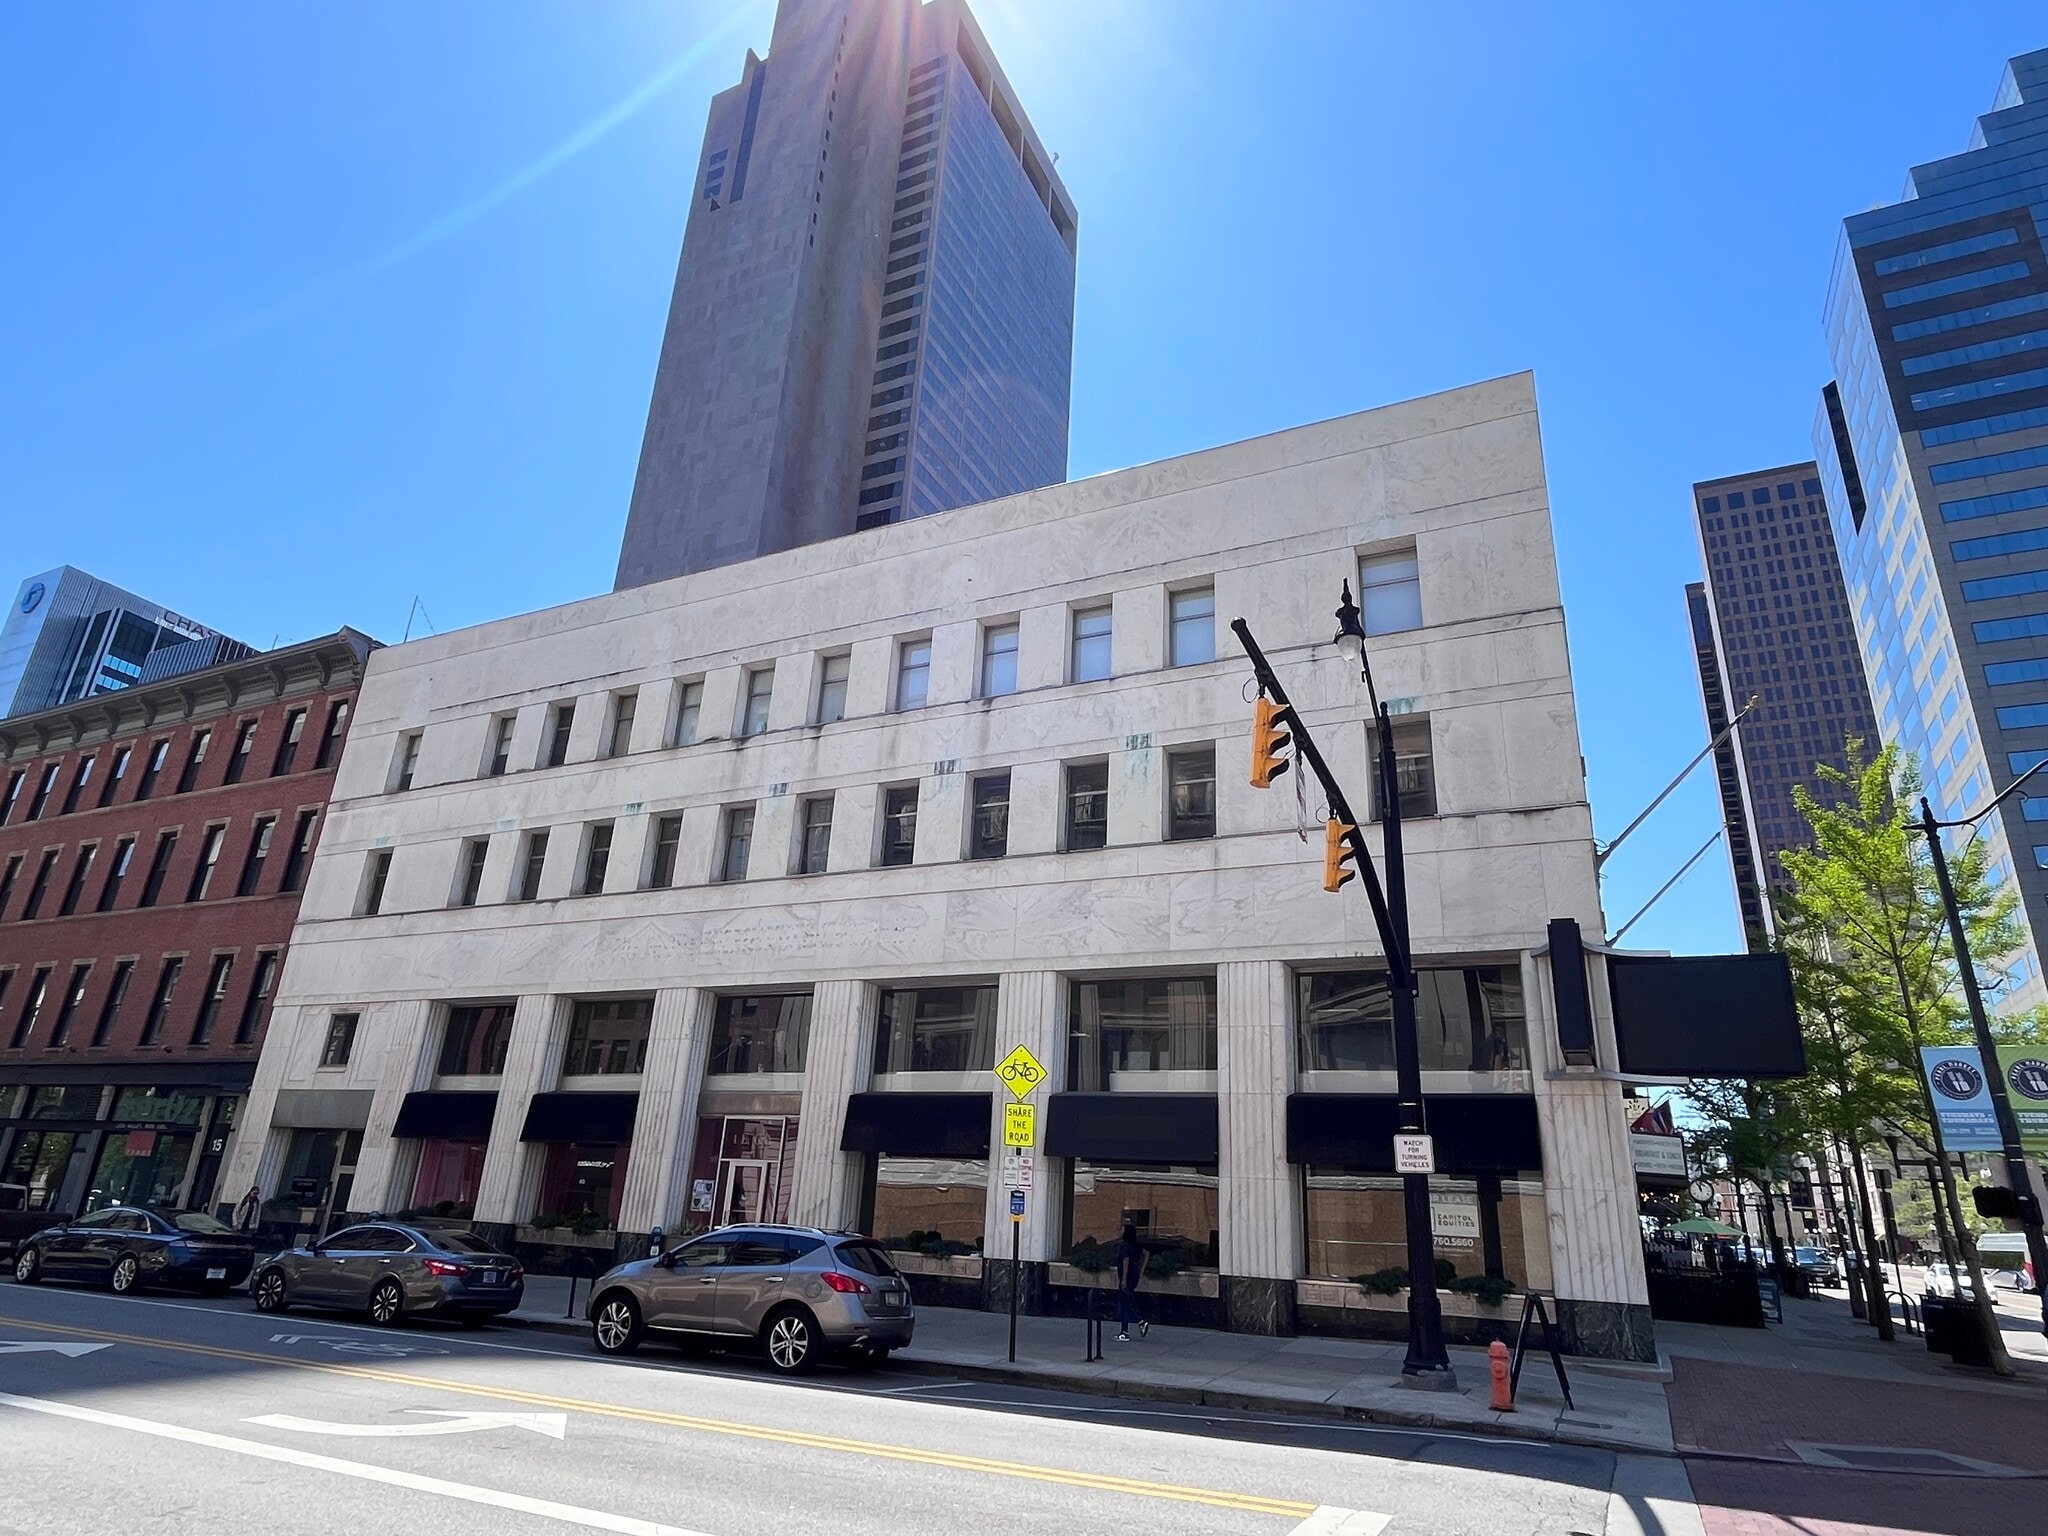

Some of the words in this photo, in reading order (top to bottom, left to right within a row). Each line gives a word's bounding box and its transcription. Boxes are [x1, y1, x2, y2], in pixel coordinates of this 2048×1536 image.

[1007, 1107, 1032, 1118] SHARE
[1012, 1120, 1027, 1130] THE
[1008, 1132, 1030, 1142] ROAD
[212, 1139, 223, 1152] 15
[1401, 1153, 1428, 1161] TURNING
[1441, 1195, 1474, 1204] LEASE
[1437, 1213, 1473, 1222] CAPITOL
[1437, 1220, 1475, 1228] EQUITIES
